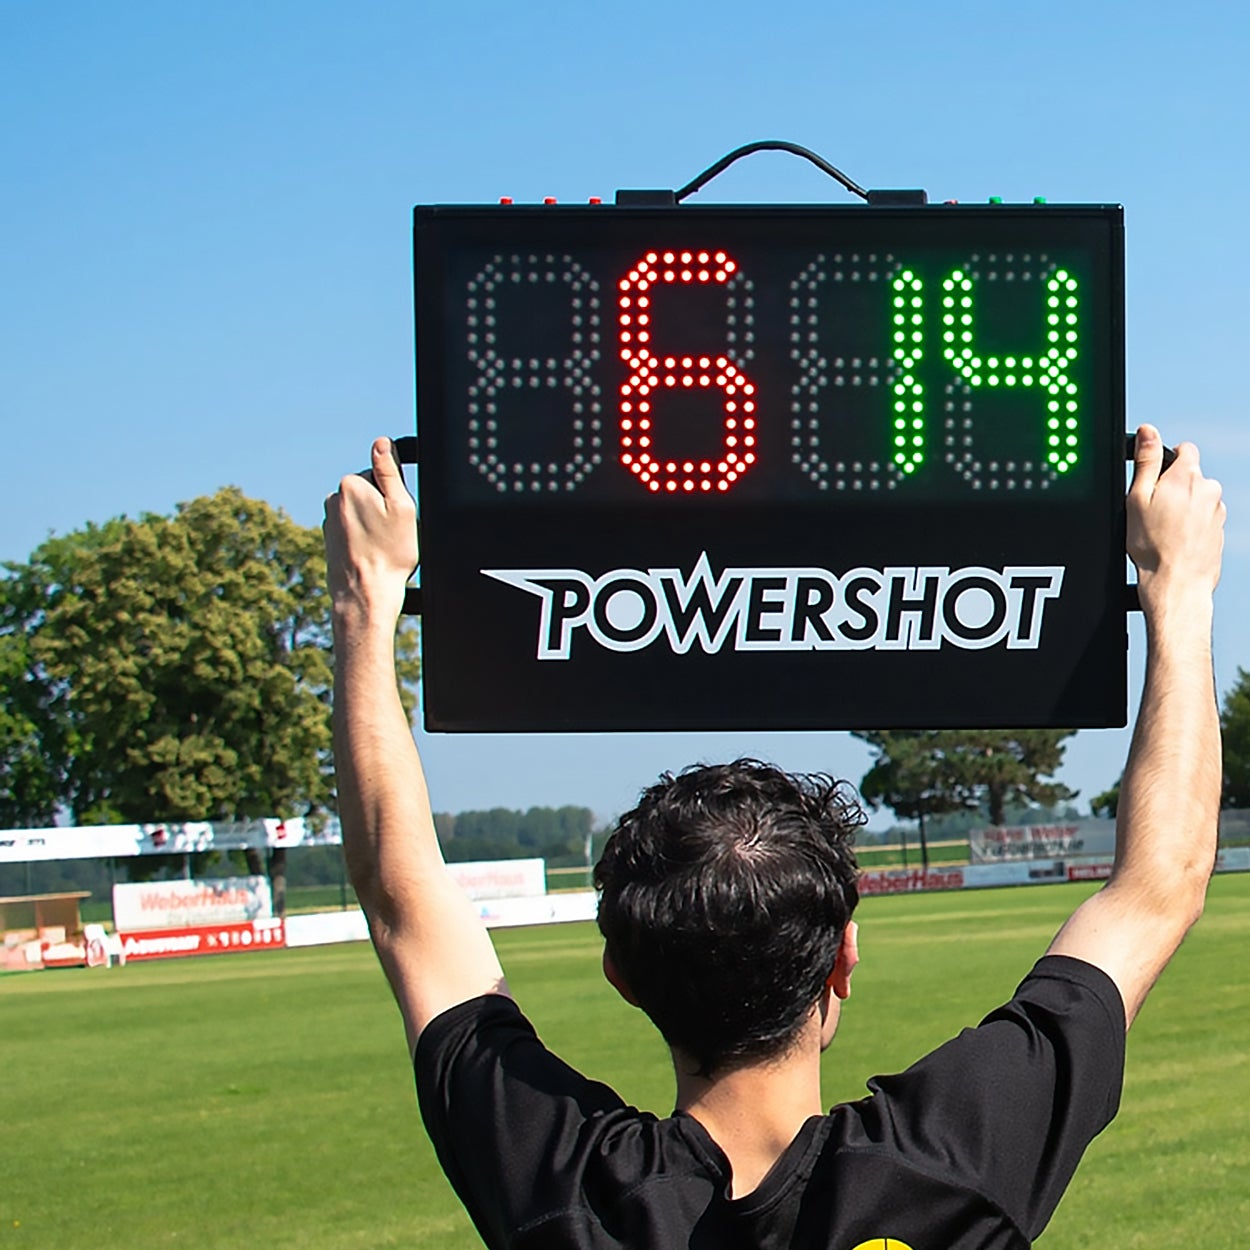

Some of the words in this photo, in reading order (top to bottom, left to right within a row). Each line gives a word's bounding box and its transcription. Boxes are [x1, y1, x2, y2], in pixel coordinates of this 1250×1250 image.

[618, 248, 756, 495] 6
[892, 267, 1080, 475] 14
[485, 556, 1064, 660] POWERSHOT
